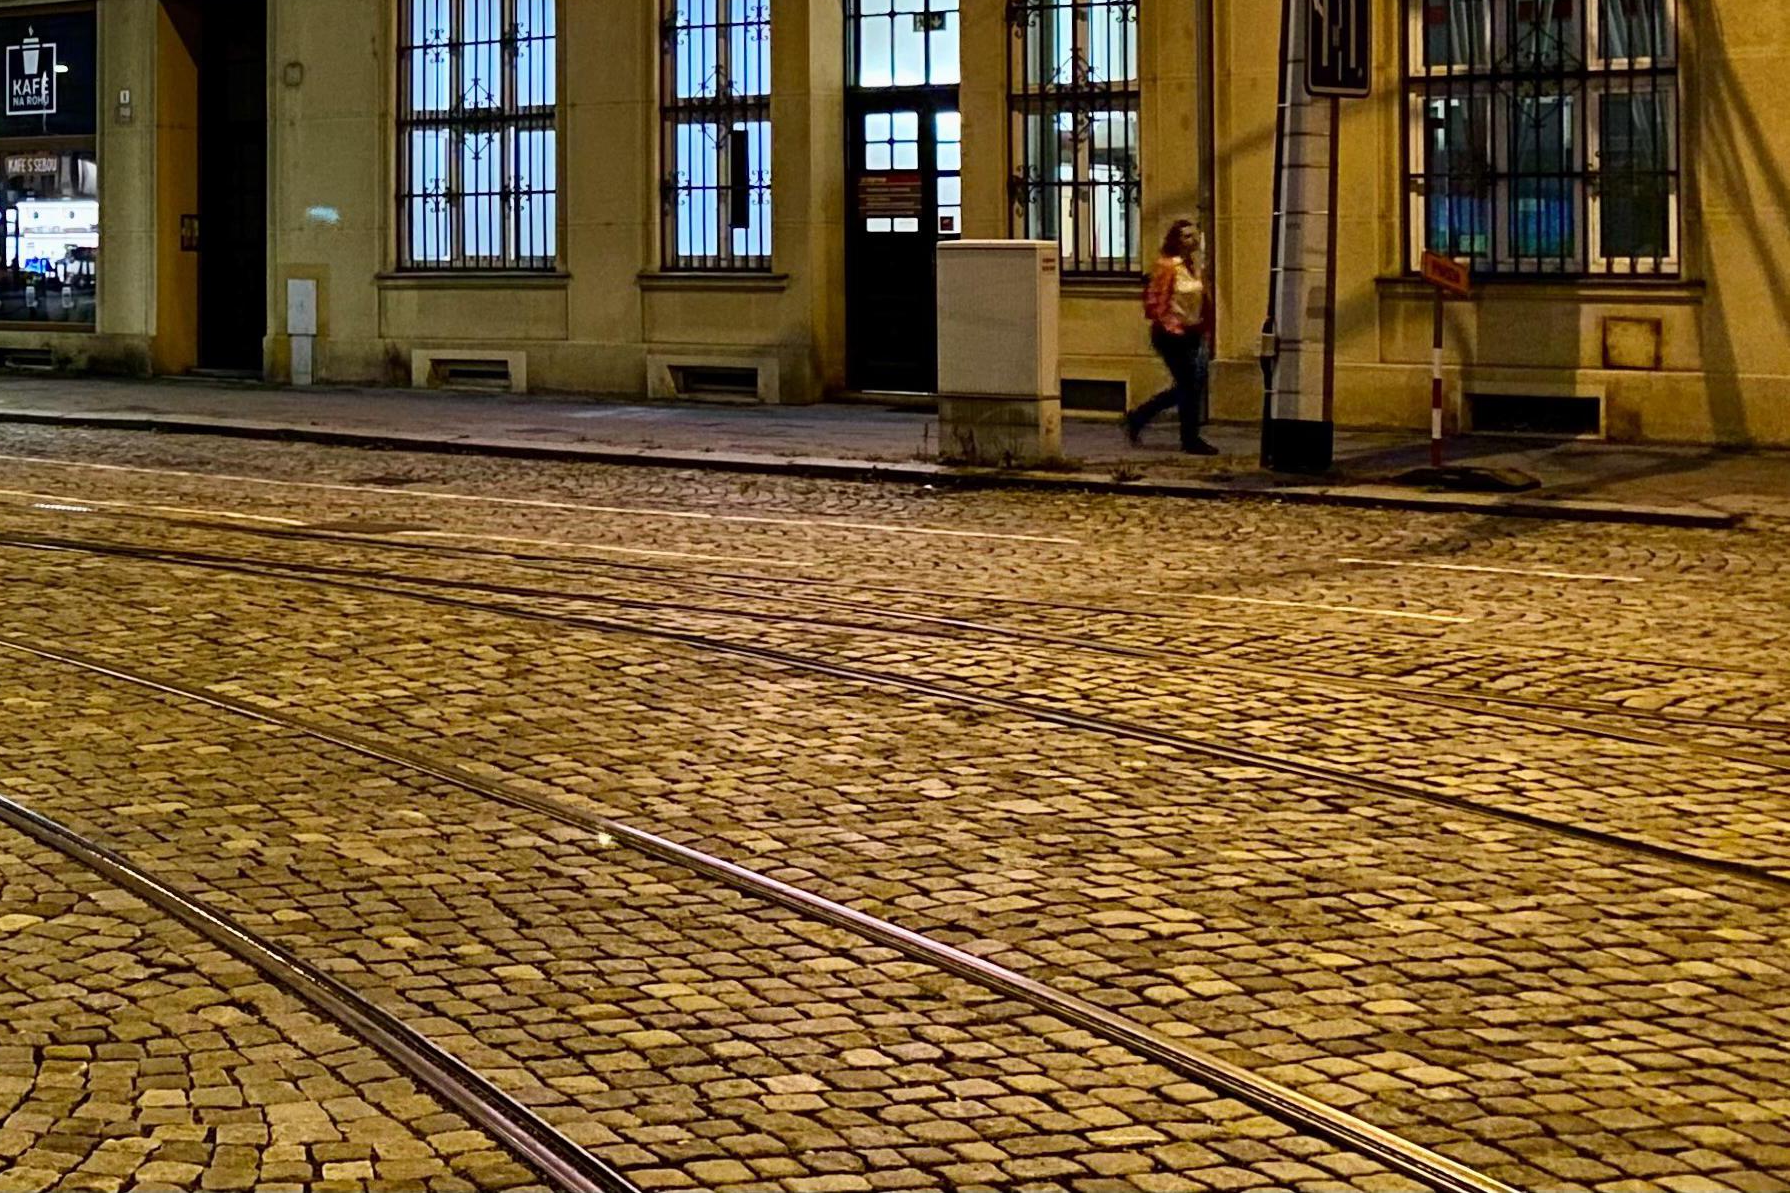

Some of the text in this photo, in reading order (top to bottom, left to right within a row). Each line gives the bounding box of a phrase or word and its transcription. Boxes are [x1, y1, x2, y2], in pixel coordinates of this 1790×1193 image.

[13, 77, 49, 96] KAFE
[13, 95, 49, 106] NA ROHU
